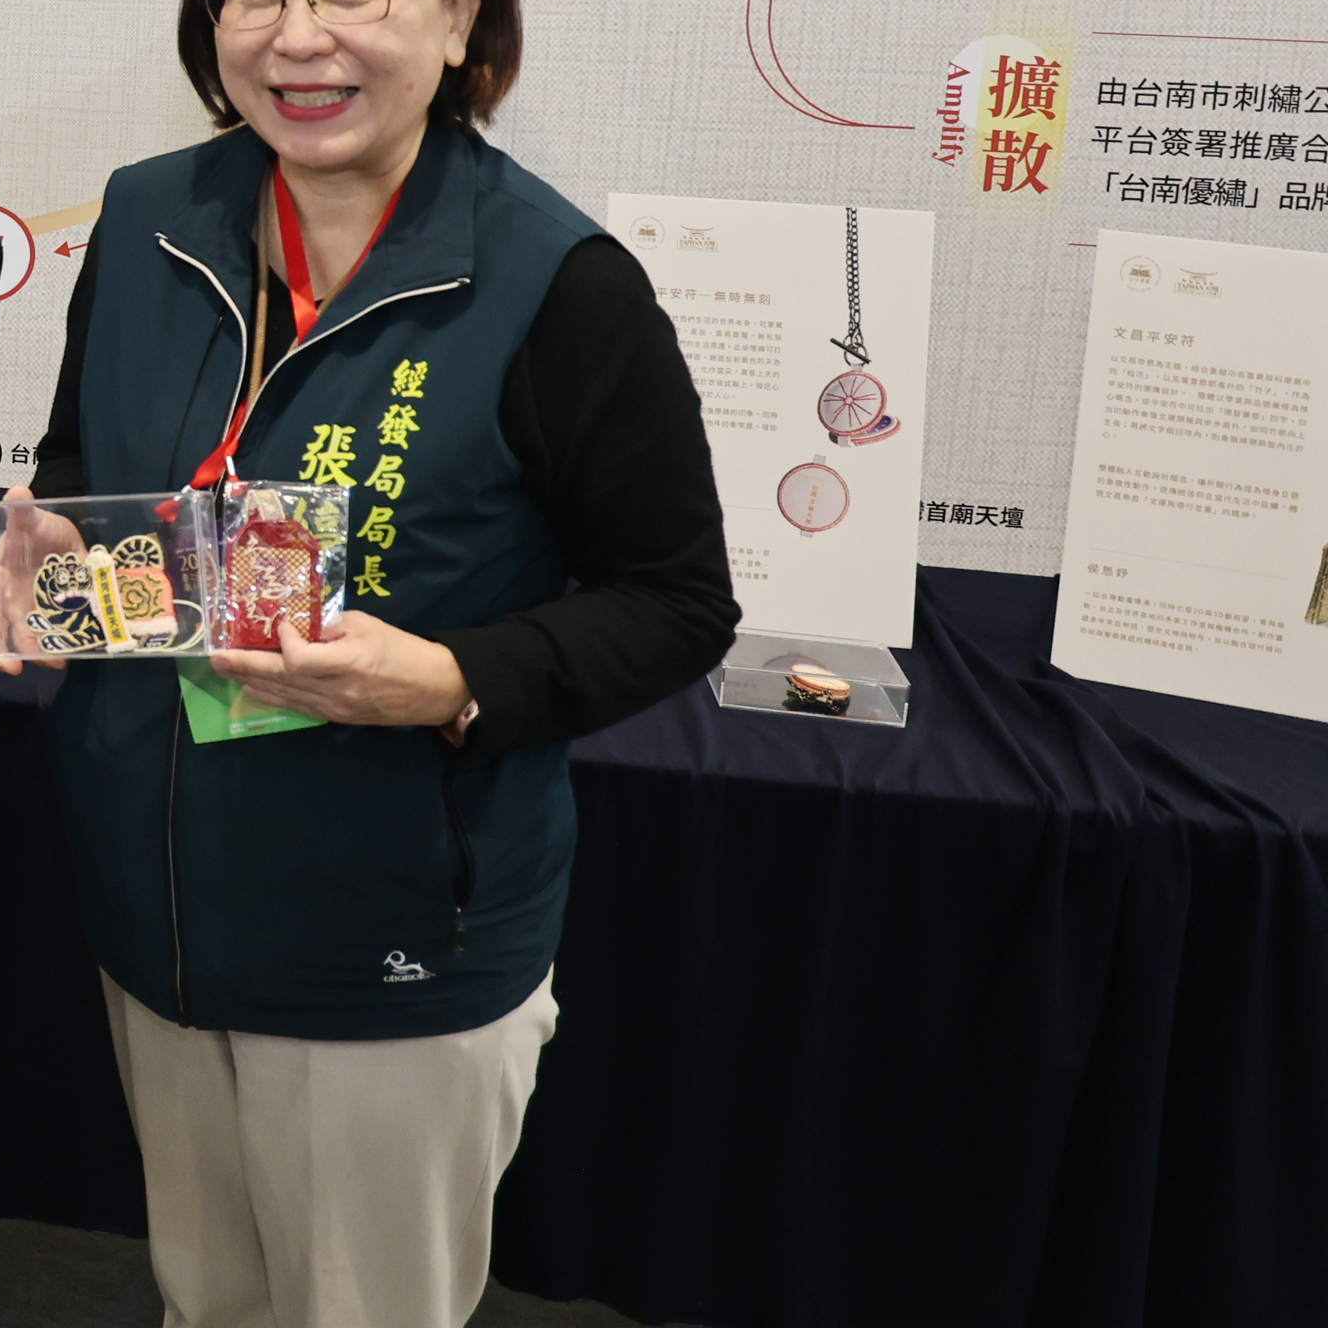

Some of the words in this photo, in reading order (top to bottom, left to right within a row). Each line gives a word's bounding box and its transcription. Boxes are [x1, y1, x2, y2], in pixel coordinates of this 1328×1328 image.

[932, 61, 971, 167] Amplify
[983, 54, 1062, 195] 擴散
[1091, 125, 1328, 164] 平台簽署推廣合
[353, 359, 430, 599] 經發局局長
[919, 500, 1025, 529] 首廟天壇
